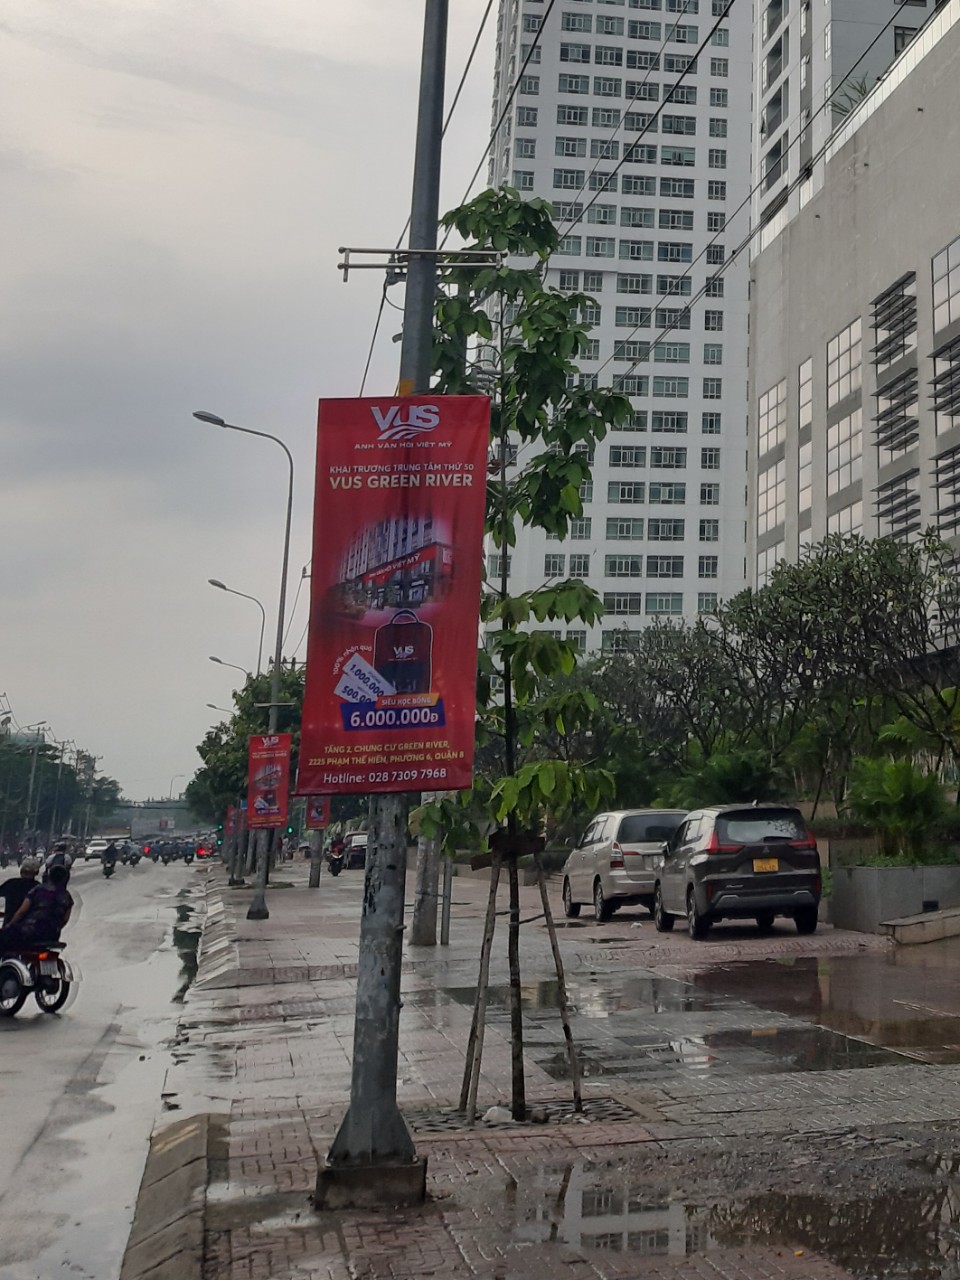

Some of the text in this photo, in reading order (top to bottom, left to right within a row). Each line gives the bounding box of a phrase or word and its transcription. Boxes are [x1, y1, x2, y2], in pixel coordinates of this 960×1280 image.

[370, 405, 440, 432] VUS
[329, 461, 475, 474] KHAI TRƯƠNG TRUNG TÂM THỨ 50
[329, 473, 473, 490] VUS GREEN RIVER
[353, 744, 383, 753] CHUNG
[383, 743, 398, 751] CƯ
[398, 742, 424, 751] GREEN
[308, 758, 326, 766] 2225
[326, 757, 350, 767] PHẠM
[389, 753, 425, 763] PHƯỜNG
[434, 750, 458, 761] QUẬN
[323, 767, 447, 784] Hotline: 028 7309 7968
